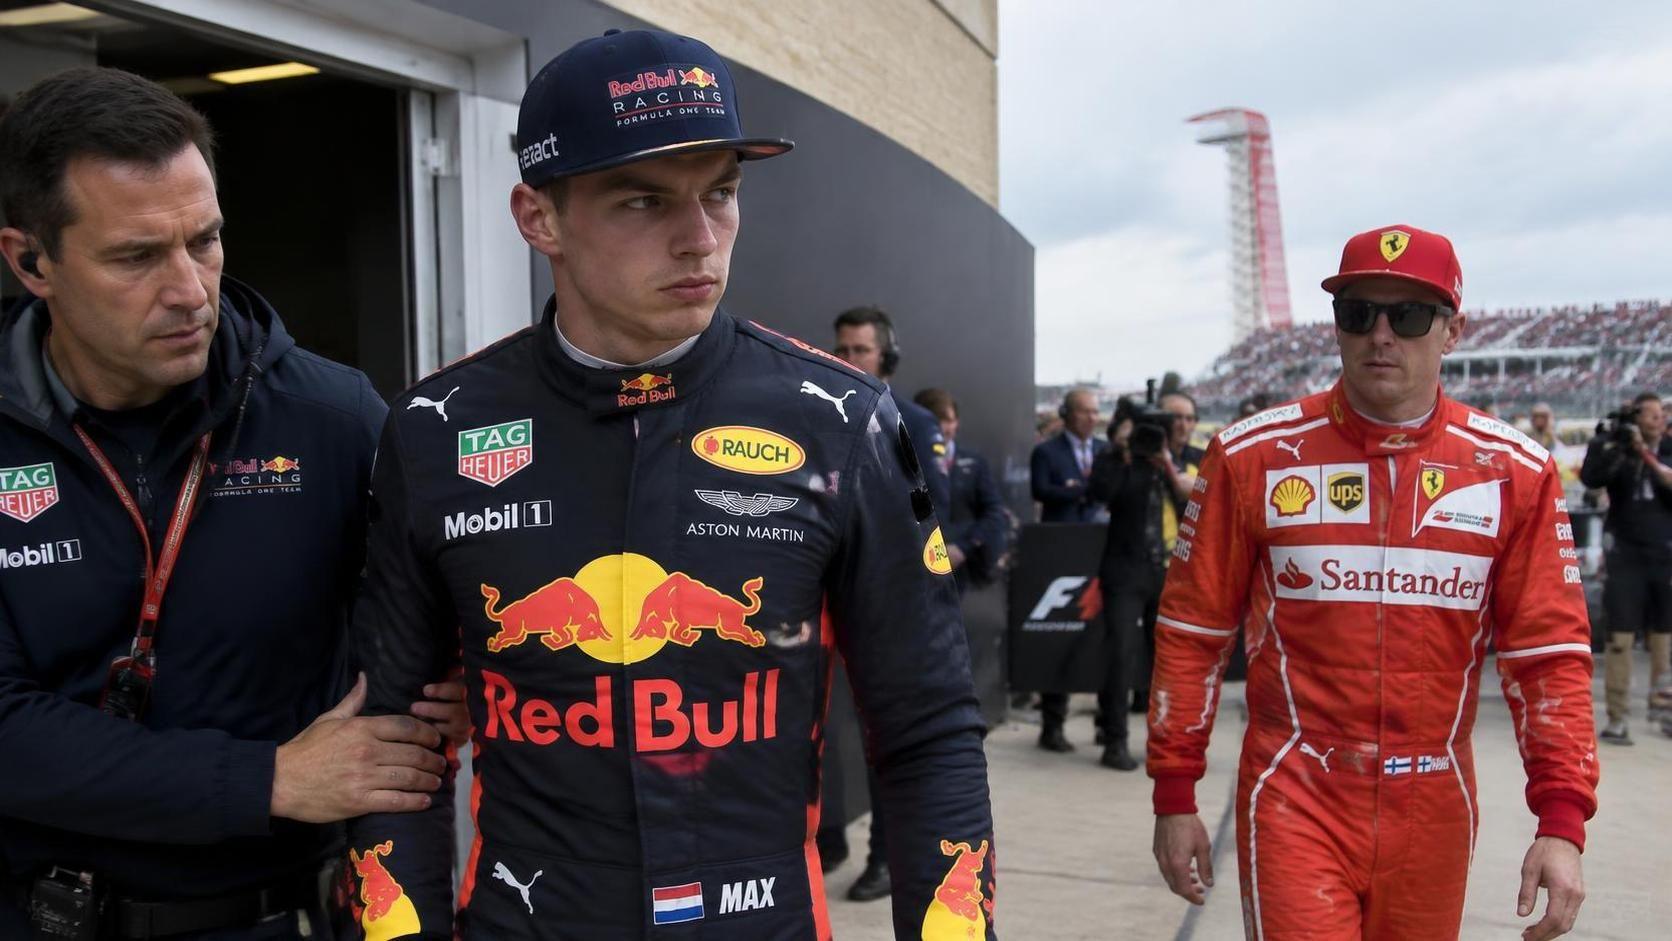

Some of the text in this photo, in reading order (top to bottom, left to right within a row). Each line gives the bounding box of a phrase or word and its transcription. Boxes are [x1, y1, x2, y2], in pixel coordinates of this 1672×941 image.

[608, 69, 677, 98] Red Bull
[613, 90, 722, 113] RACING
[617, 110, 673, 127] FORMULA
[617, 386, 676, 407] Red Bull
[465, 424, 526, 452] TAG
[722, 438, 790, 463] RAUCH
[462, 449, 529, 482] HEUER
[0, 468, 50, 490] TAG
[224, 474, 301, 486] ACING
[1330, 484, 1363, 507] ups
[444, 502, 541, 540] Mobil 1
[686, 522, 804, 542] ASTON MARTIN
[62, 542, 73, 559] 1
[1320, 558, 1484, 600] Santander
[481, 668, 780, 752] Red Bull
[719, 876, 776, 914] MAX
